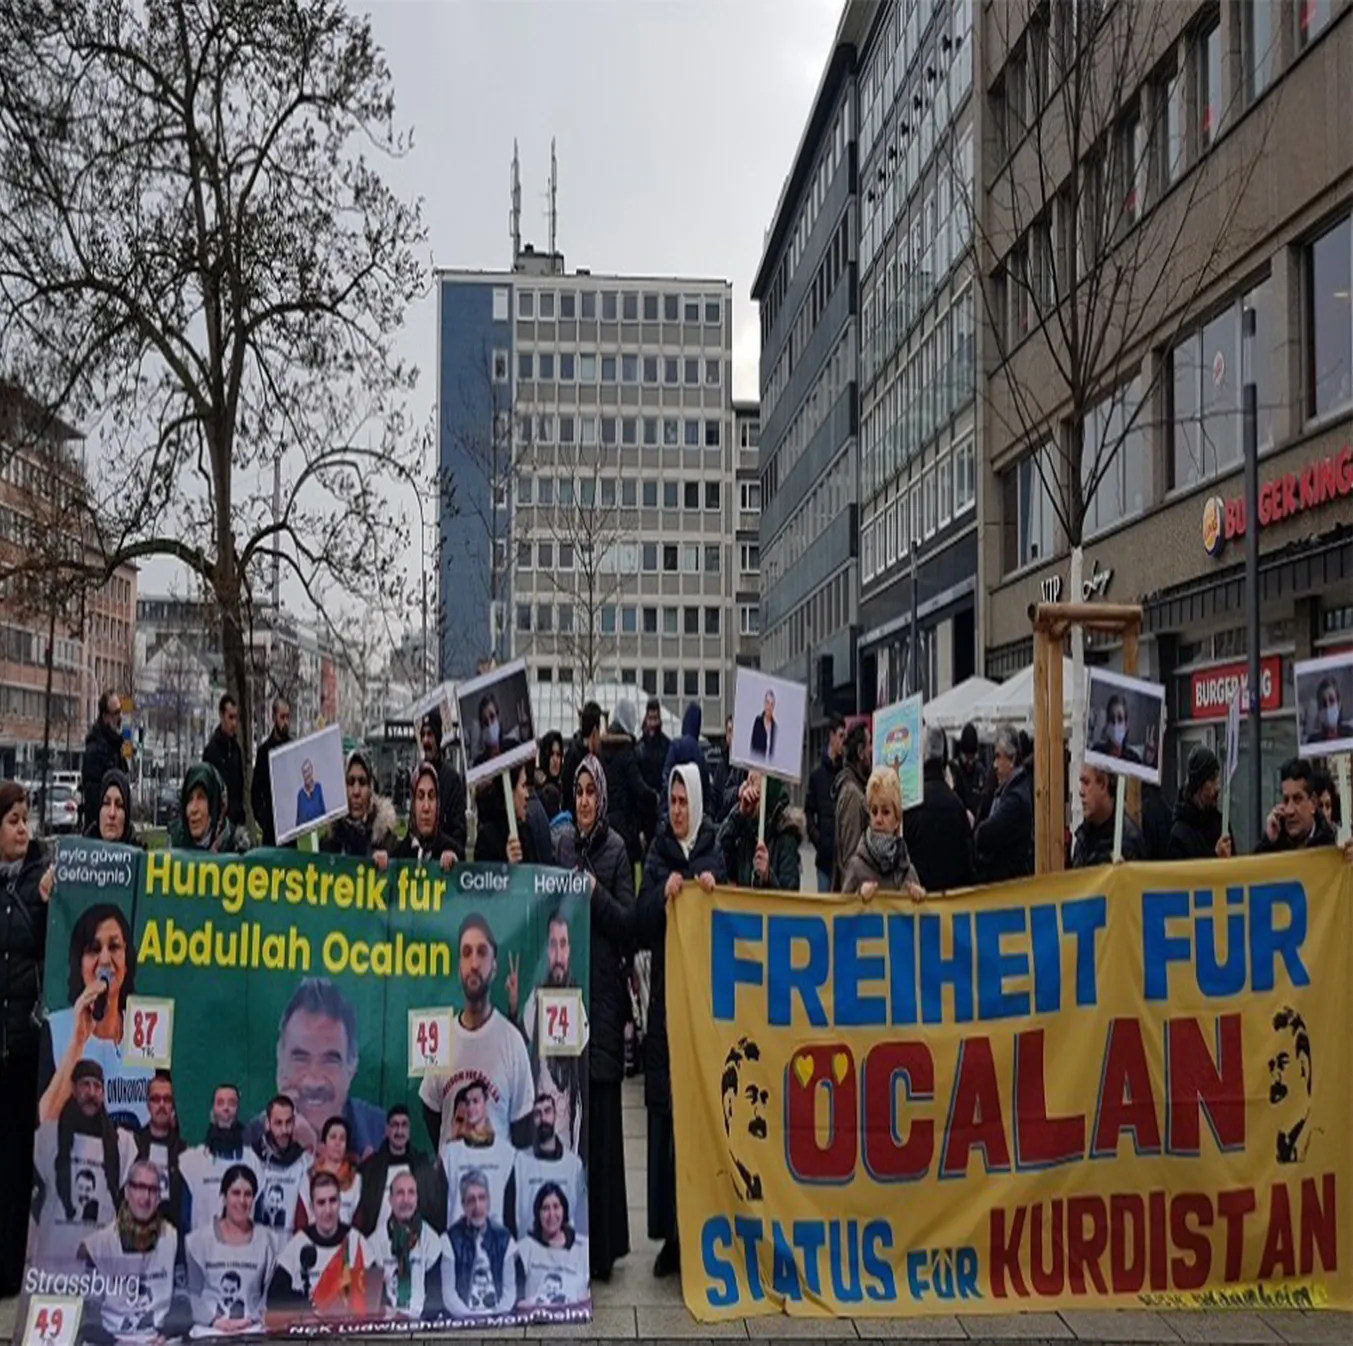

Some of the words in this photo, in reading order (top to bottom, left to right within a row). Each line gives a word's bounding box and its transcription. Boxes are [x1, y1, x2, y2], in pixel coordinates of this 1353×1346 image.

[1224, 472, 1296, 539] BUGER
[1299, 441, 1353, 510] KING
[1195, 676, 1239, 708] BURGER
[1239, 669, 1272, 710] KG
[145, 852, 387, 914] Hungerstreik
[398, 866, 447, 913] für
[459, 870, 511, 890] Galler
[534, 872, 589, 894] Hewler
[137, 919, 311, 970] Abdullah
[321, 929, 451, 976] Ocalan
[709, 894, 1107, 1028] FREIHEIT
[1141, 879, 1311, 1003] FÜR
[133, 1009, 159, 1049] 87
[417, 1020, 439, 1055] 49
[546, 1005, 569, 1037] 74
[783, 1012, 1247, 1188] ÖCALAN
[700, 1214, 894, 1309] STATUS
[906, 1246, 985, 1301] FÜR
[987, 1172, 1339, 1300] KURDISTAN
[24, 1267, 141, 1306] Strassburg
[35, 1307, 63, 1339] 49
